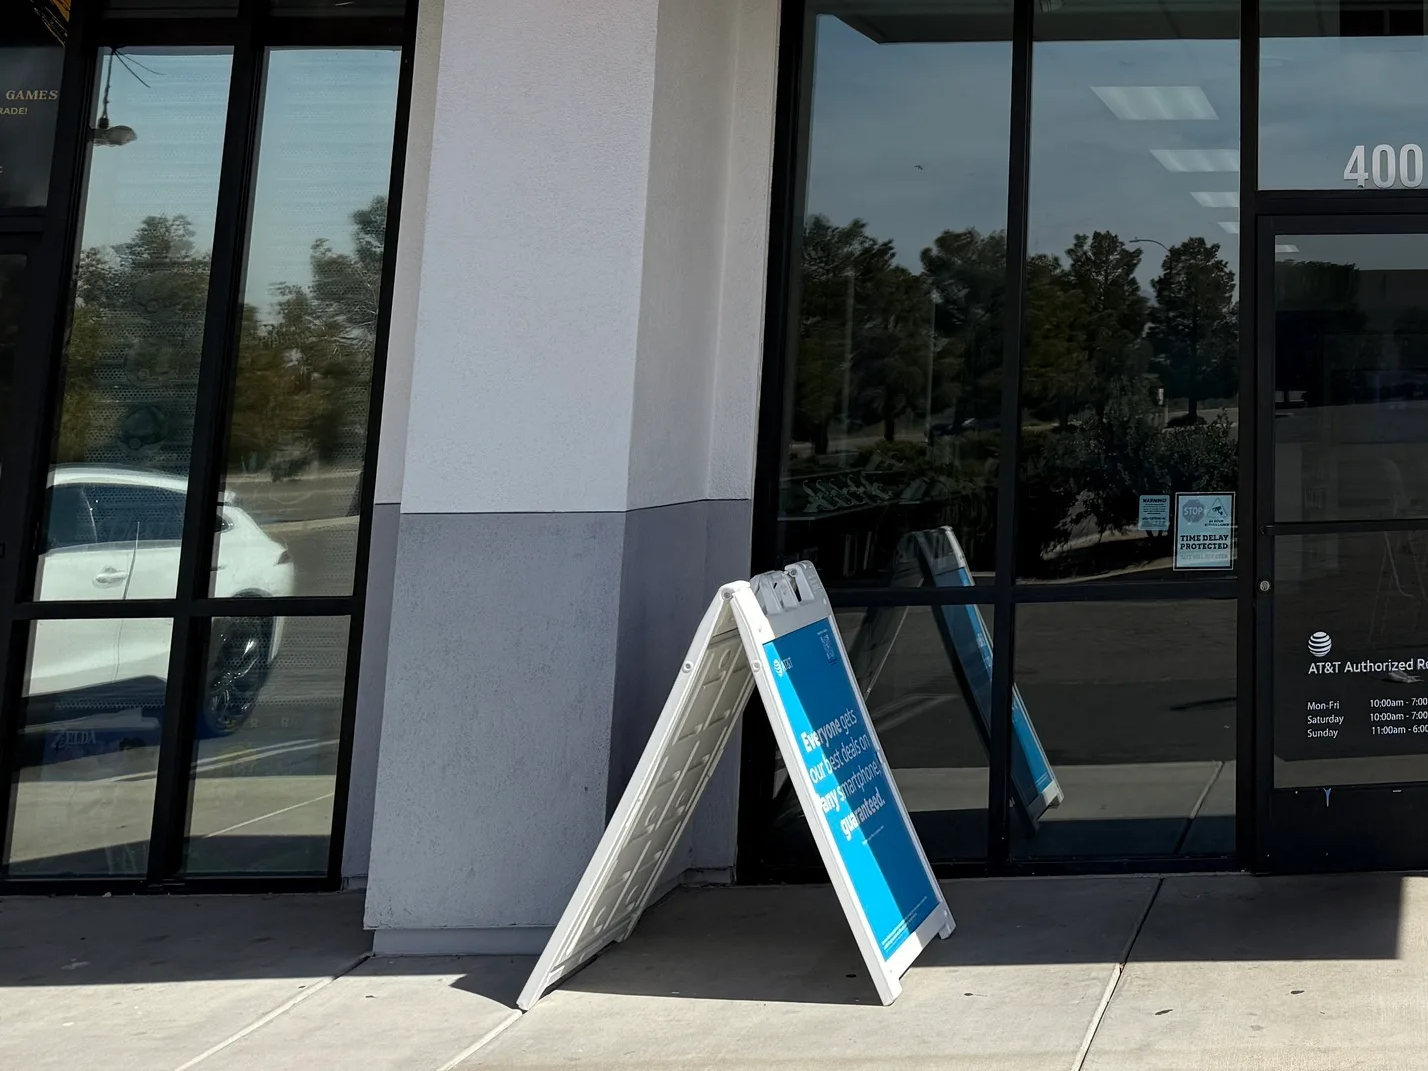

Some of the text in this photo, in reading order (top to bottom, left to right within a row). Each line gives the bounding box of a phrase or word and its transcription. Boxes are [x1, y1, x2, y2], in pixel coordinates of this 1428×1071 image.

[5, 89, 58, 100] GAMES
[1343, 143, 1424, 189] 400
[1184, 508, 1203, 516] STOP
[1180, 534, 1201, 542] TIME
[1308, 661, 1341, 675] AT&T
[1344, 658, 1414, 673] Authorized
[1307, 700, 1340, 711] Mon-Fri
[1370, 698, 1404, 708] 10:00am
[1307, 714, 1344, 725] Saturday
[1370, 712, 1404, 722] 10:00am
[801, 708, 857, 753] Everyone gets
[1307, 729, 1339, 739] Sunday
[1372, 725, 1406, 735] 11:00am
[809, 734, 870, 784] our best deals on
[820, 790, 841, 814] any
[840, 787, 886, 841] guaranteed.
